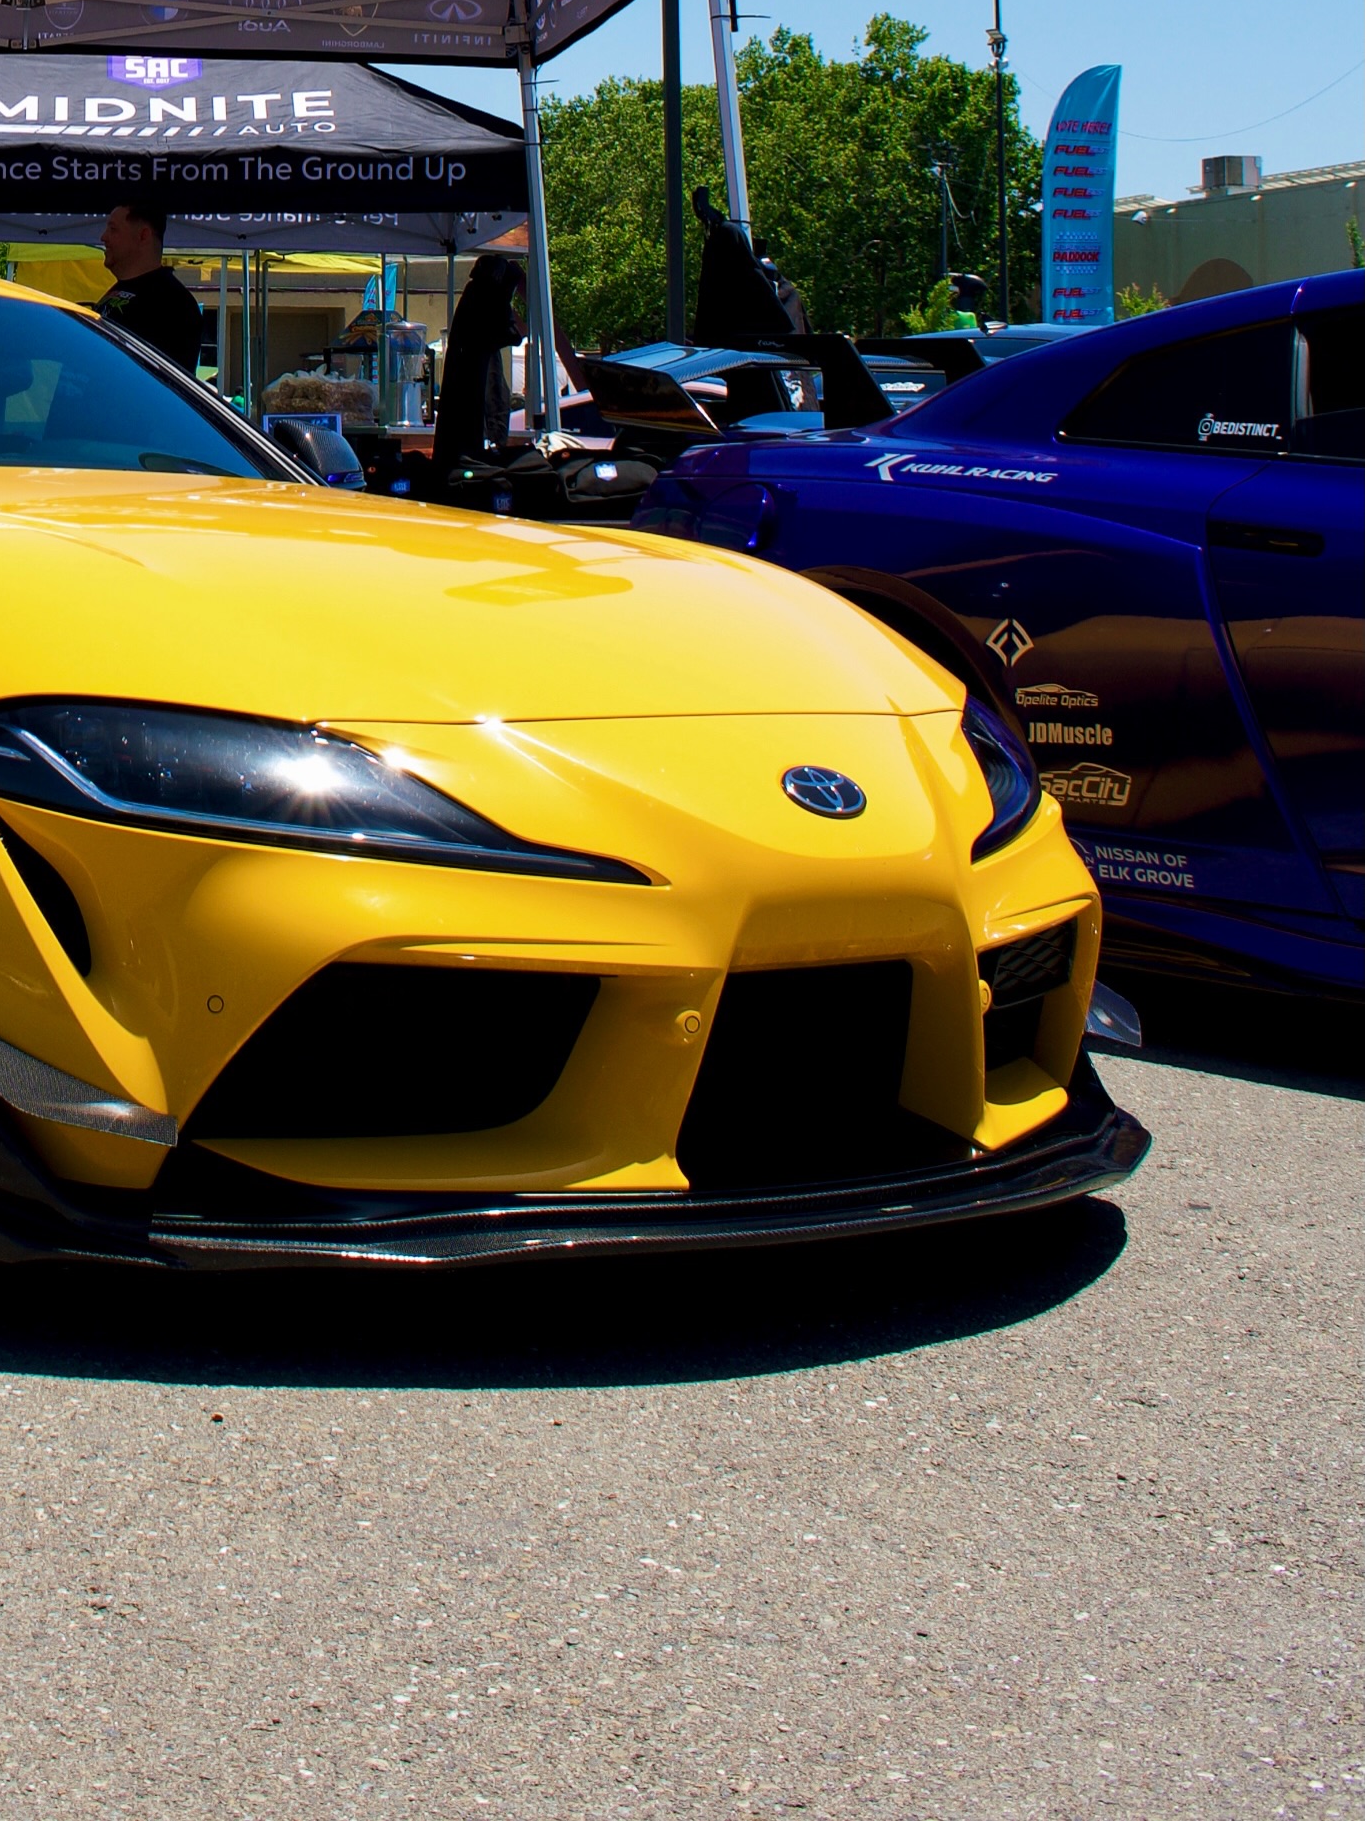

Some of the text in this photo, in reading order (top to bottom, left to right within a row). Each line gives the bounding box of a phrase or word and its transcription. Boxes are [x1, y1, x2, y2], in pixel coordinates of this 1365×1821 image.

[125, 58, 188, 78] SAC
[237, 121, 337, 136] AUTO
[51, 156, 142, 181] Starts
[151, 157, 229, 181] From
[238, 156, 293, 181] The
[301, 155, 415, 181] Ground
[424, 156, 467, 187] Up
[900, 463, 965, 476] KUHL
[962, 467, 1059, 483] RACING
[1016, 694, 1099, 709] Opelite Optics
[1028, 722, 1113, 746] JDMuscle
[1038, 772, 1132, 807] SacCity
[1094, 845, 1161, 866] NISSAN
[1163, 853, 1188, 868] OF
[1098, 864, 1195, 888] ELK GROVE
